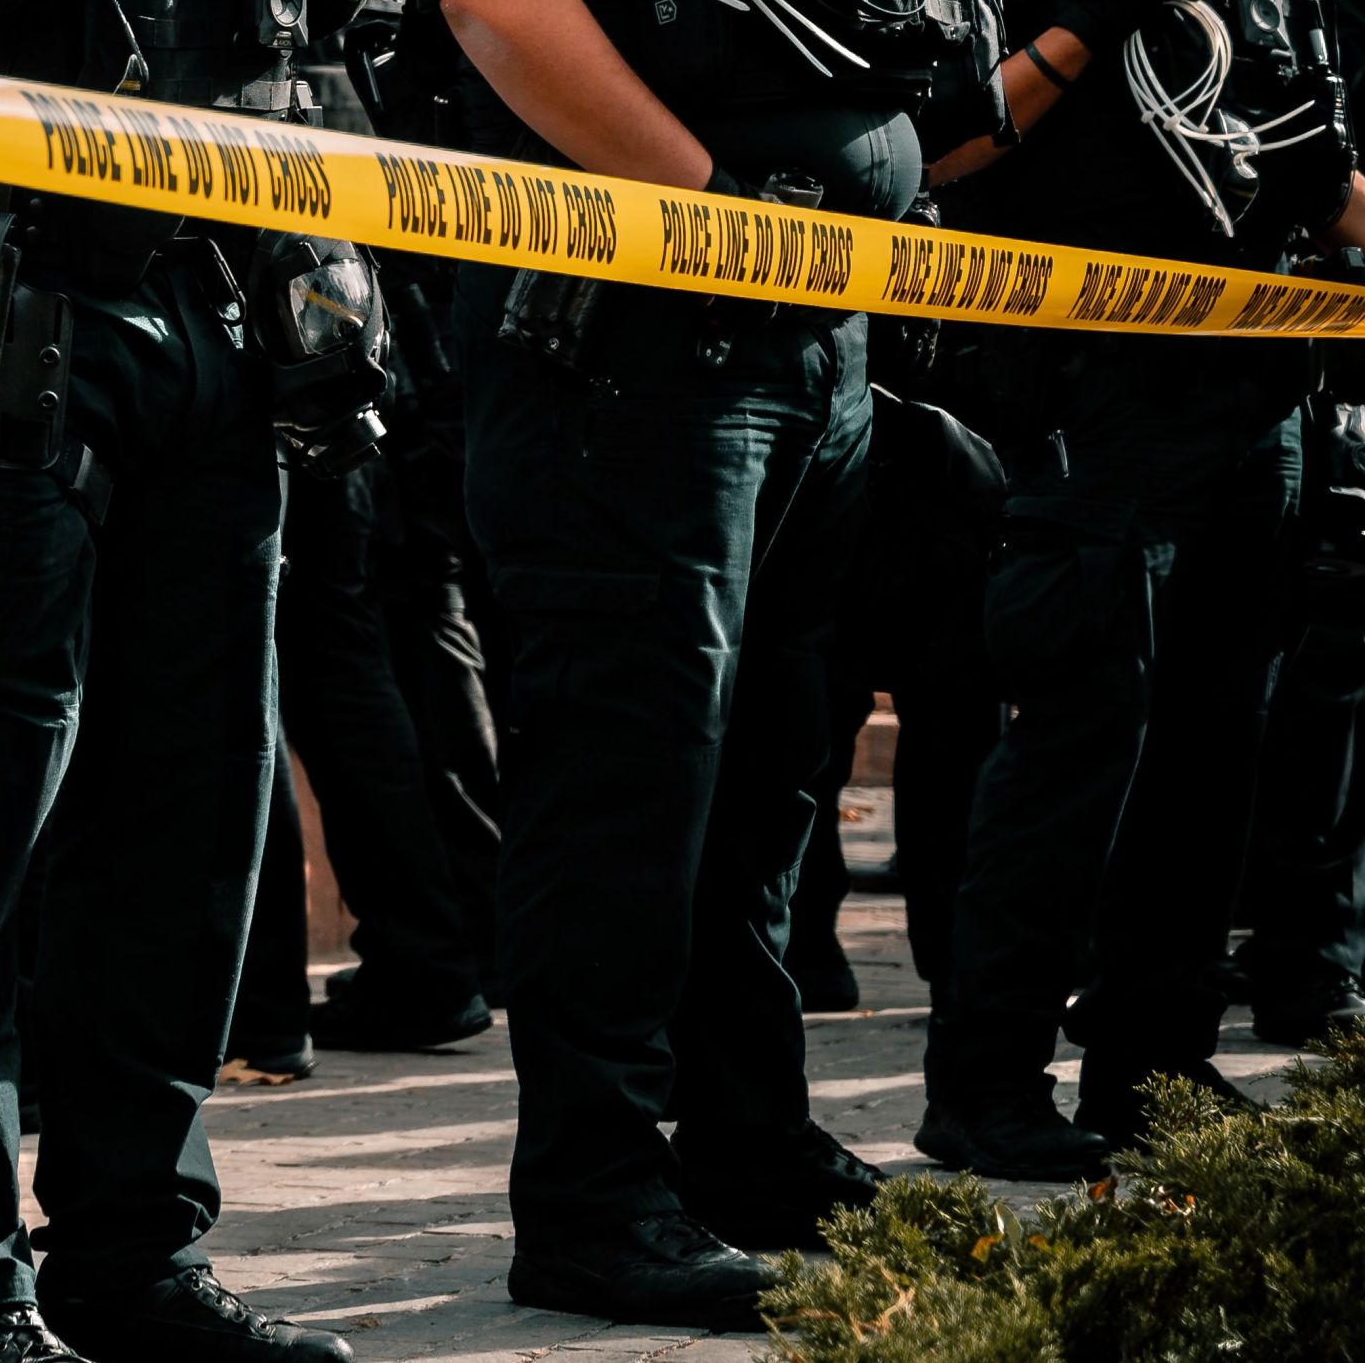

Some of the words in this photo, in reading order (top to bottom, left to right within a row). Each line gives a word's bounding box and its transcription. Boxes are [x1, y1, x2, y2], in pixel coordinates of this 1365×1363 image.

[21, 91, 121, 182] POLICE
[109, 106, 178, 192] LINE
[167, 116, 213, 199] DO
[204, 121, 259, 206] NOT
[254, 129, 331, 219] CROSS
[375, 152, 447, 238] POLICE
[445, 163, 493, 245] LINE
[491, 171, 522, 250] DO
[521, 176, 558, 255] NOT
[562, 182, 617, 265] CROSS
[659, 199, 712, 277] POLICE
[714, 208, 749, 283] LINE
[750, 213, 774, 286] DO
[773, 217, 806, 289] NOT
[805, 222, 854, 296] CROSS
[881, 235, 934, 305] POLICE
[926, 241, 966, 308] LINE
[956, 246, 986, 310] DO
[975, 248, 1014, 312] NOT
[1002, 251, 1054, 317] CROSS
[1066, 261, 1123, 321] POLICE
[1105, 267, 1151, 323] LINE
[1130, 270, 1168, 325] DO
[1147, 272, 1192, 326] NOT
[1170, 274, 1227, 328] CROSS
